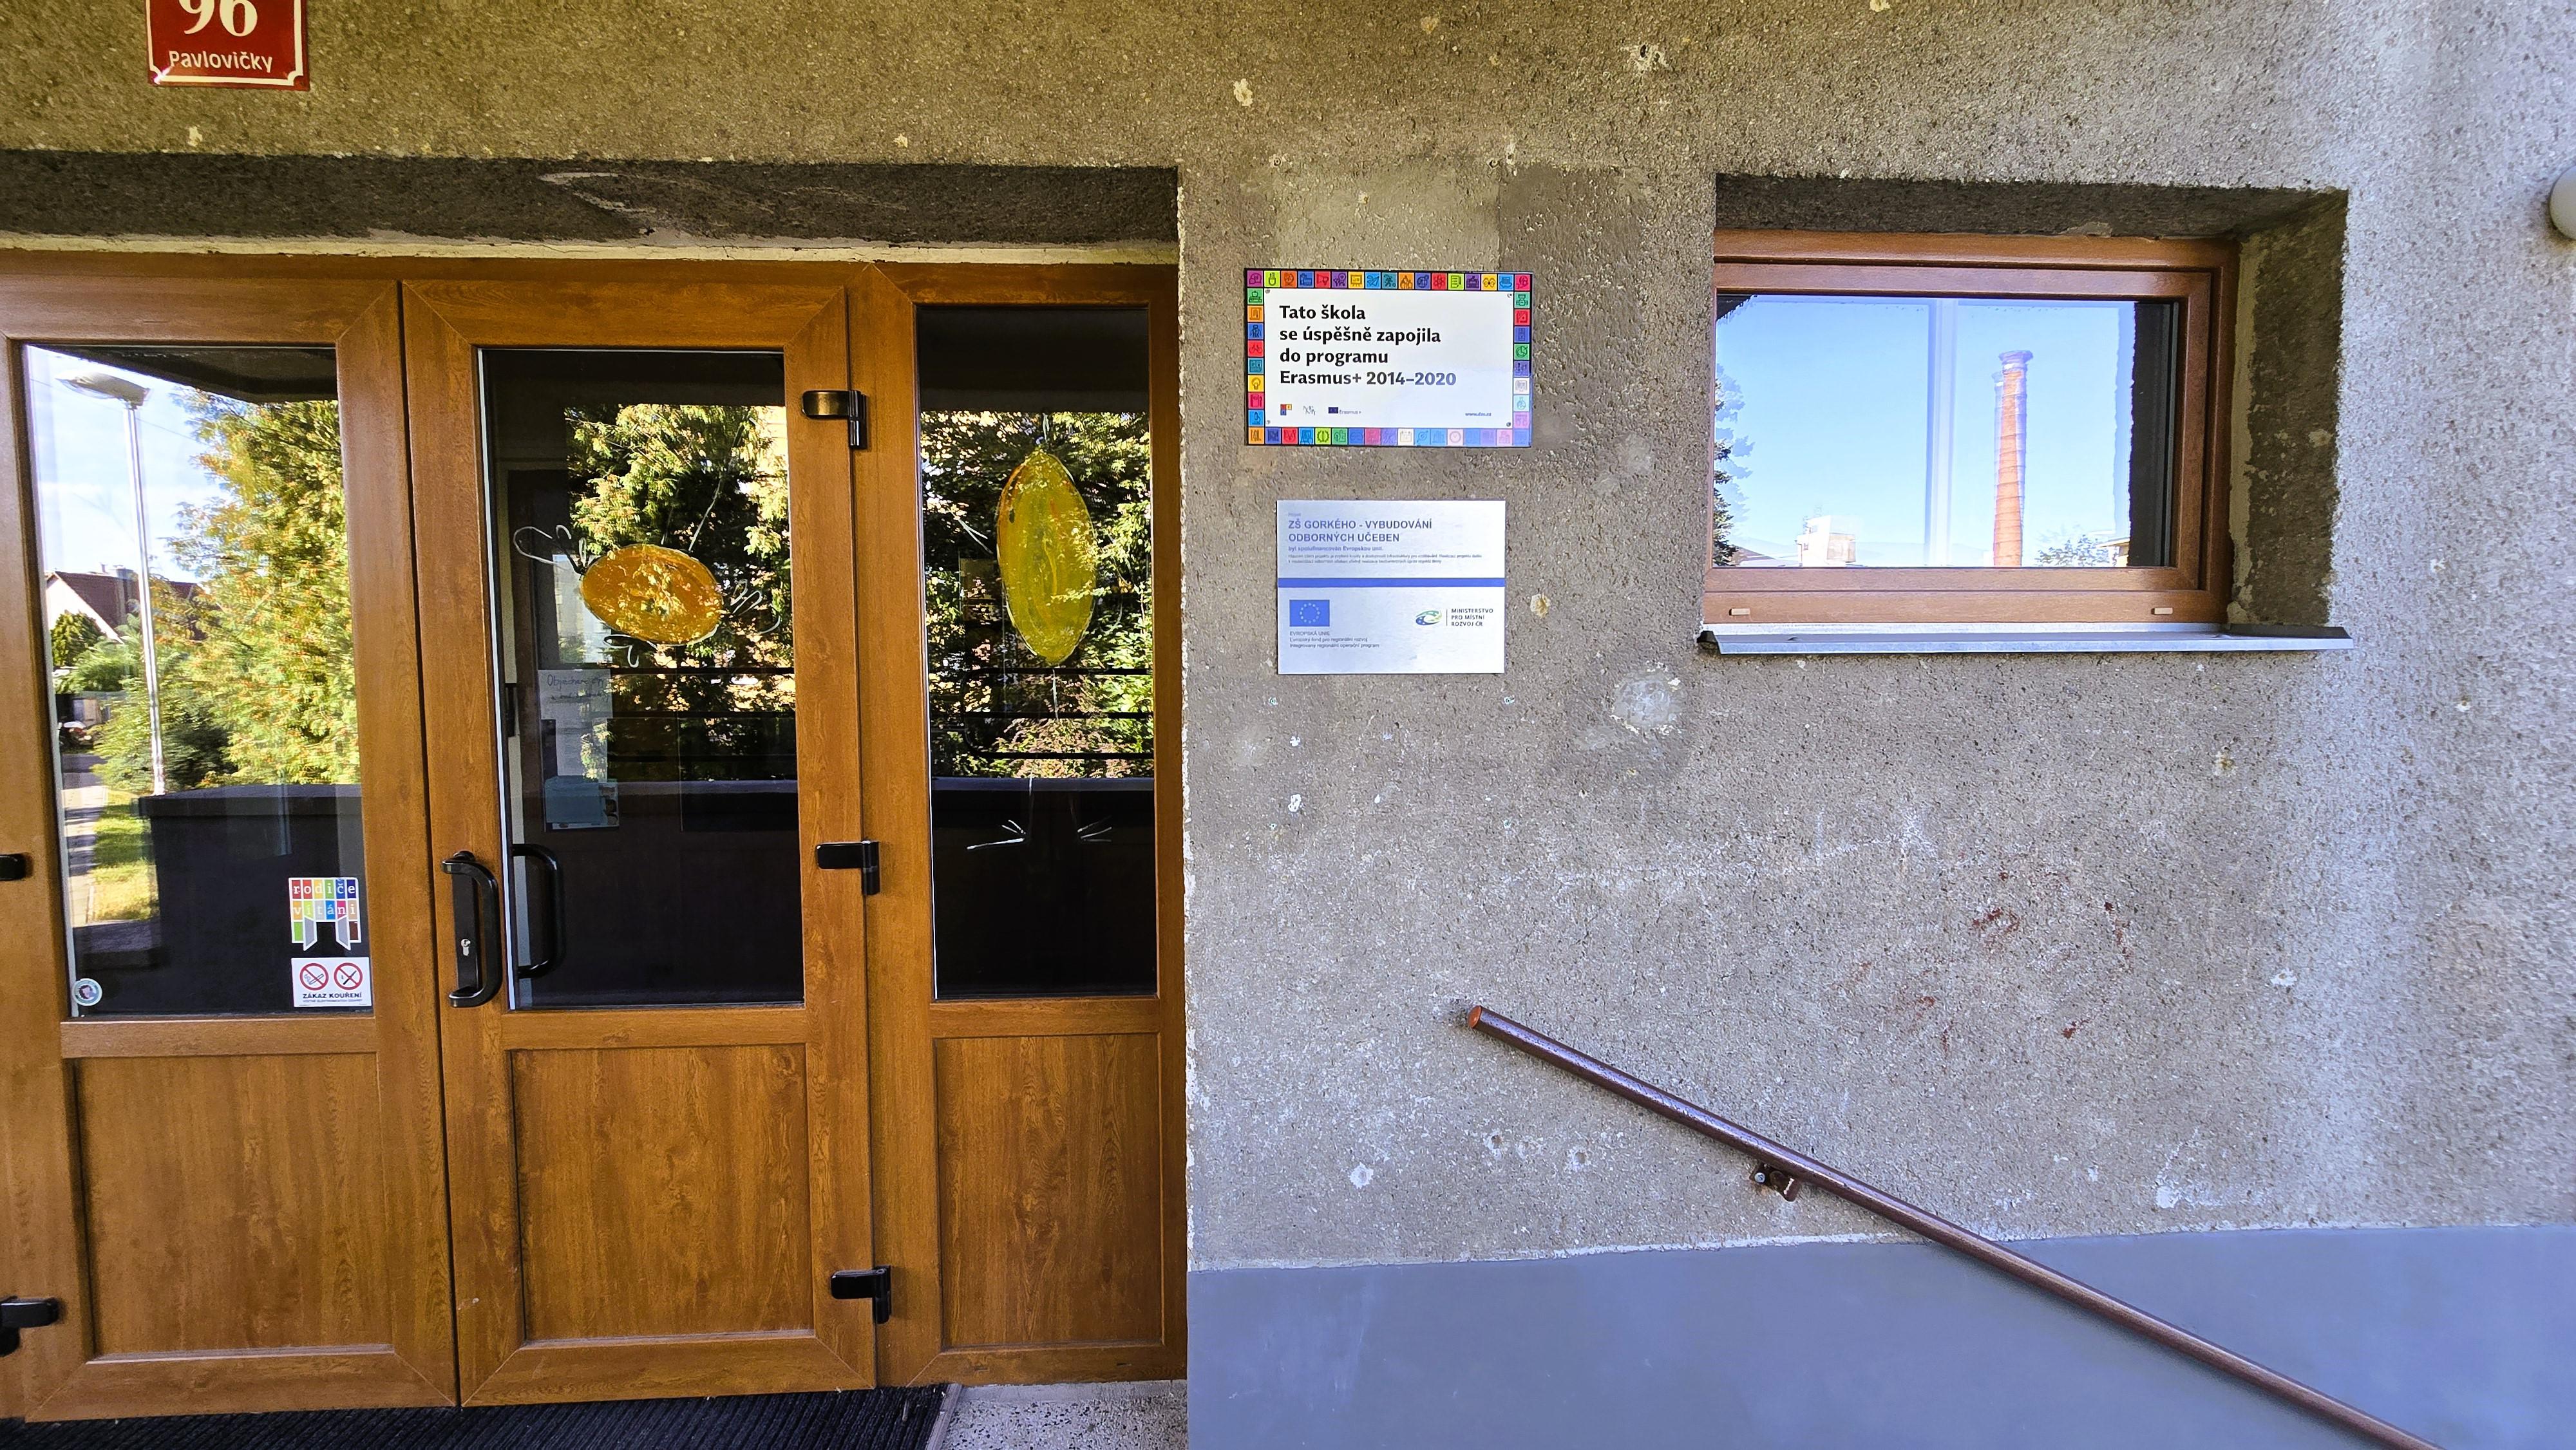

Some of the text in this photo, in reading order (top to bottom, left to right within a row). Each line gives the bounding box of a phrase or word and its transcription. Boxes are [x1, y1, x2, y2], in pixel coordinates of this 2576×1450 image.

[178, 0, 258, 37] 96
[168, 50, 272, 73] Pavlovičky
[1279, 304, 1366, 320] Tato škola
[1280, 325, 1441, 346] se úspěšně zapojila
[1280, 347, 1388, 367] do programu
[1280, 370, 1362, 386] Erasmus+
[1288, 518, 1302, 529] ZŠ
[1304, 518, 1356, 529] GORKÉHO
[1365, 518, 1432, 529] VYBUDOVÁNÍ
[1288, 531, 1400, 542] ODBORNÝCH UČEBEN
[292, 882, 356, 894] rodiče
[292, 903, 356, 916] vítáni
